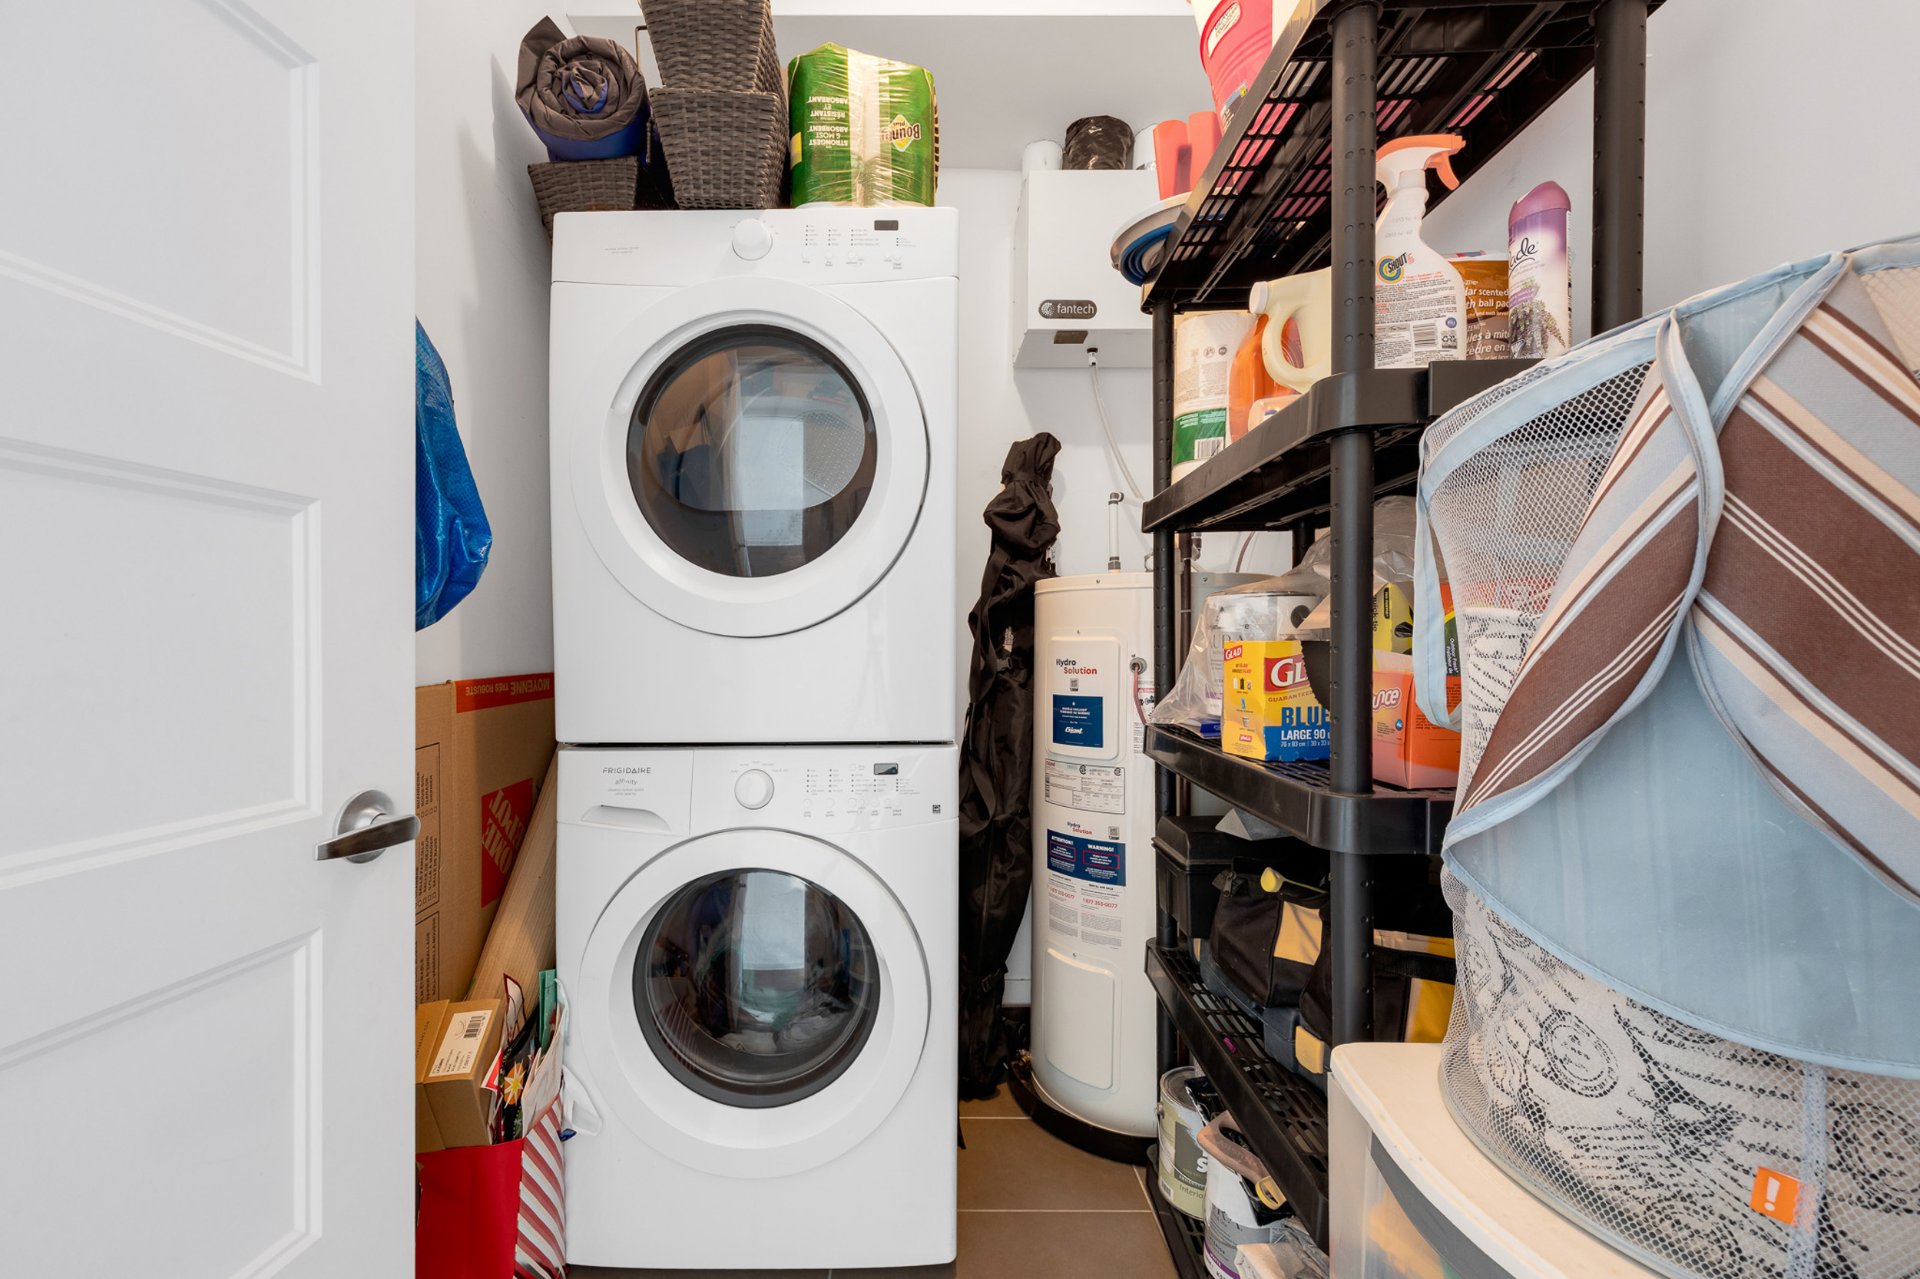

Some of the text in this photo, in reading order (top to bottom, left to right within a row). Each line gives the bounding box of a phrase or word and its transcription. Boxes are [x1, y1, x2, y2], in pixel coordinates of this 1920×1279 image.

[1057, 303, 1095, 314] fantech
[1479, 299, 1494, 308] ball
[1056, 659, 1077, 668] Hydro
[1063, 667, 1098, 675] Solution
[465, 684, 494, 696] ROBUSTE
[510, 678, 550, 695] MOYENNE
[1281, 728, 1326, 741] LARGE 90
[1087, 844, 1115, 852] WARNING!
[1180, 1184, 1204, 1199] Interio
